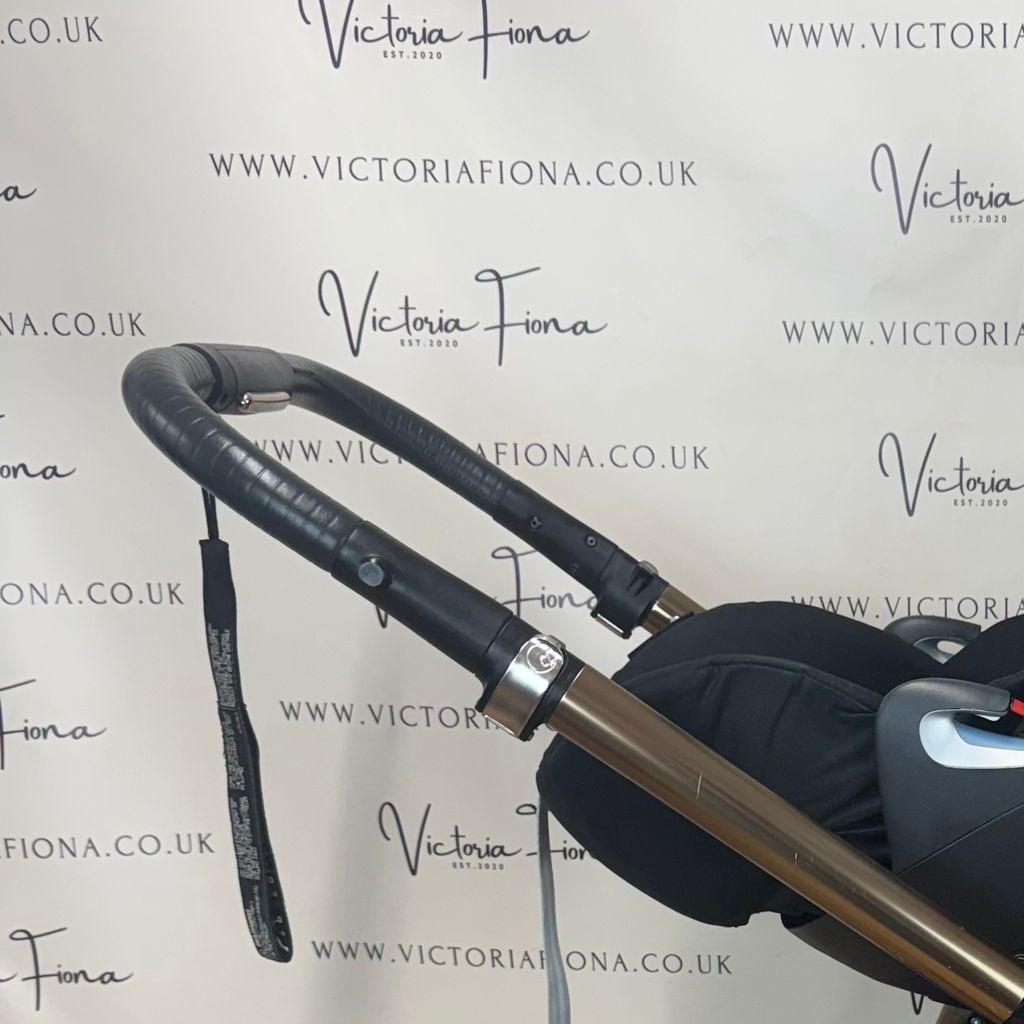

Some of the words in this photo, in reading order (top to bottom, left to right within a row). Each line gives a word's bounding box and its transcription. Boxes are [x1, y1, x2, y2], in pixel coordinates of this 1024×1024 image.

[383, 50, 442, 59] EST.2020
[209, 153, 697, 186] WWW.VICTORIAFIONA.CO.UK
[950, 215, 1006, 223] EST.2020
[318, 269, 478, 358] Victoria
[475, 267, 607, 366] Fiona
[400, 339, 458, 347] EST.2020
[0, 833, 214, 860] FIONA.CO.UK
[378, 802, 521, 876] Victoria
[5, 927, 133, 1011] Fiona
